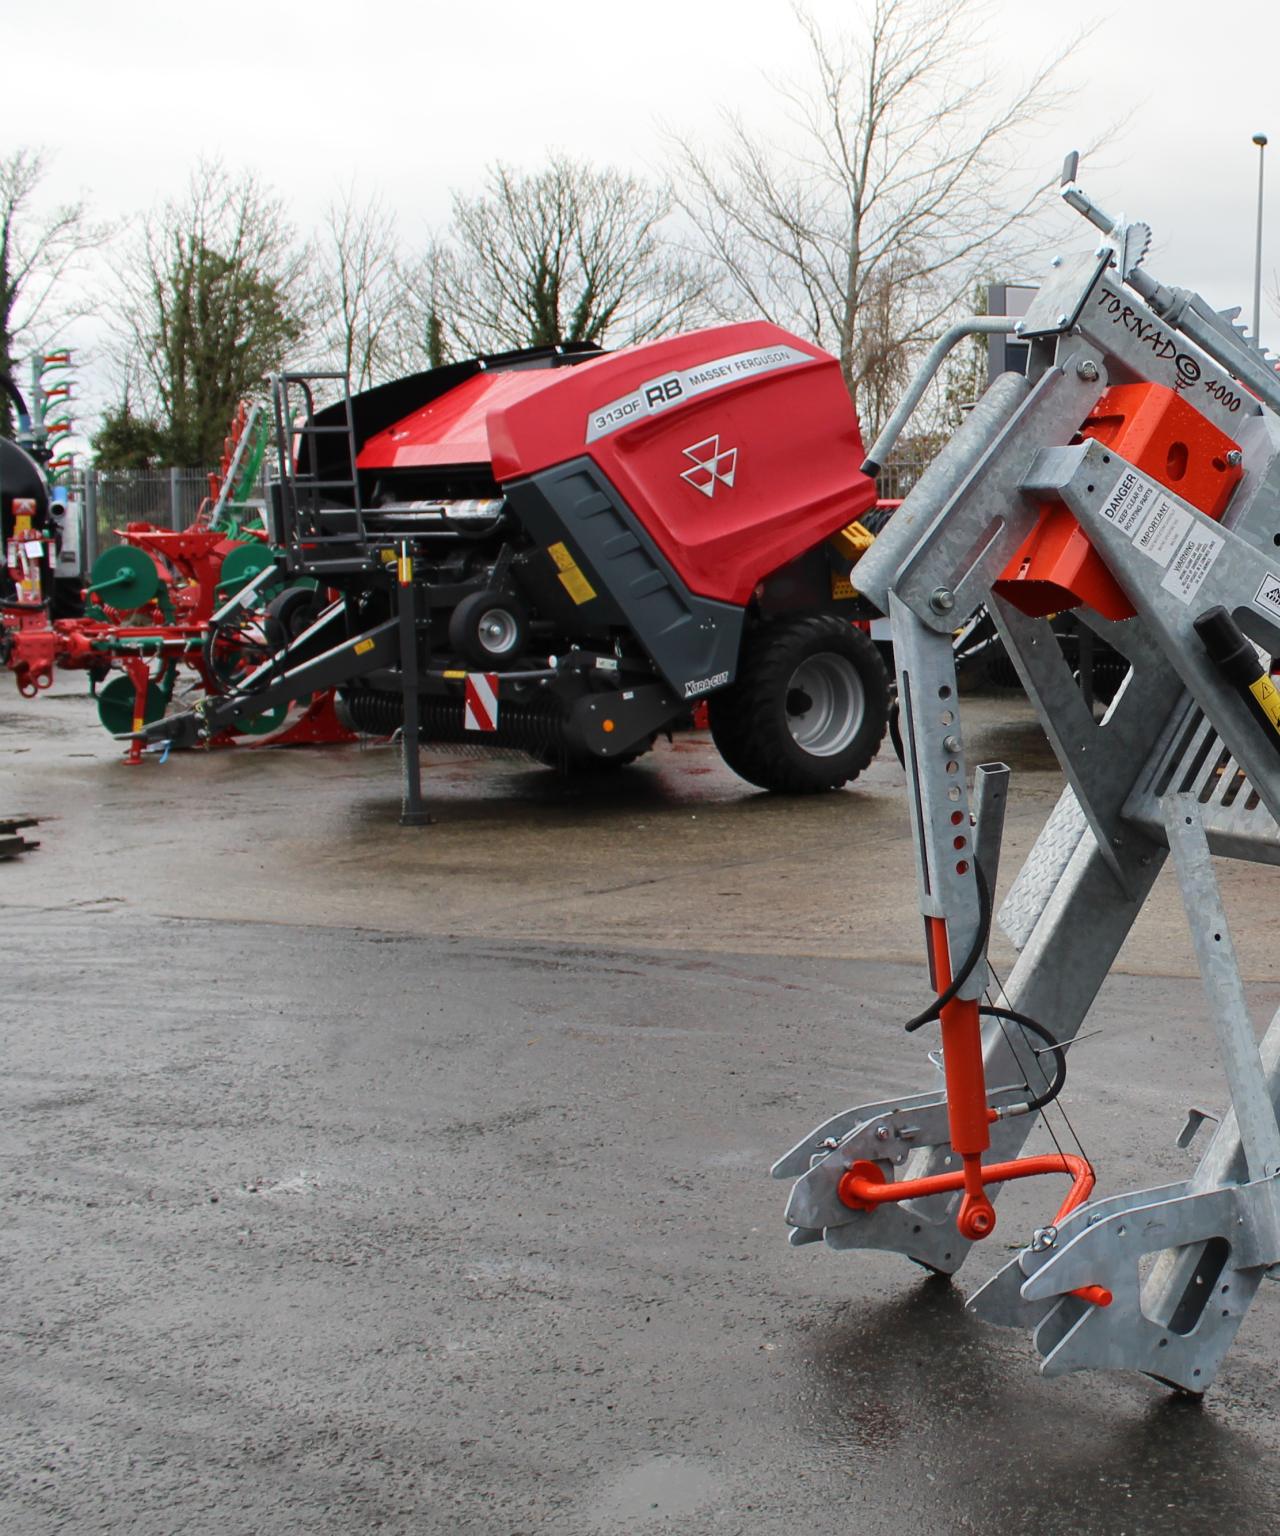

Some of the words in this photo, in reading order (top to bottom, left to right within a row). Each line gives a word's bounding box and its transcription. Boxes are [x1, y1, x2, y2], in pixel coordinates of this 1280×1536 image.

[1098, 288, 1201, 393] TORNADO
[1205, 380, 1241, 412] 4000
[595, 399, 641, 429] 3130F
[645, 378, 683, 408] RB
[688, 365, 733, 387] MASSEY
[736, 351, 791, 371] FERGUSON
[1104, 473, 1137, 519] DANGER
[1118, 509, 1129, 524] KEEP
[1126, 491, 1140, 510] CLEAR
[1137, 483, 1144, 493] OF
[1124, 505, 1143, 531] ROTATING
[1140, 487, 1153, 506] PARTS
[1139, 502, 1169, 546] IMPORTANT
[1173, 540, 1195, 572] WARNING
